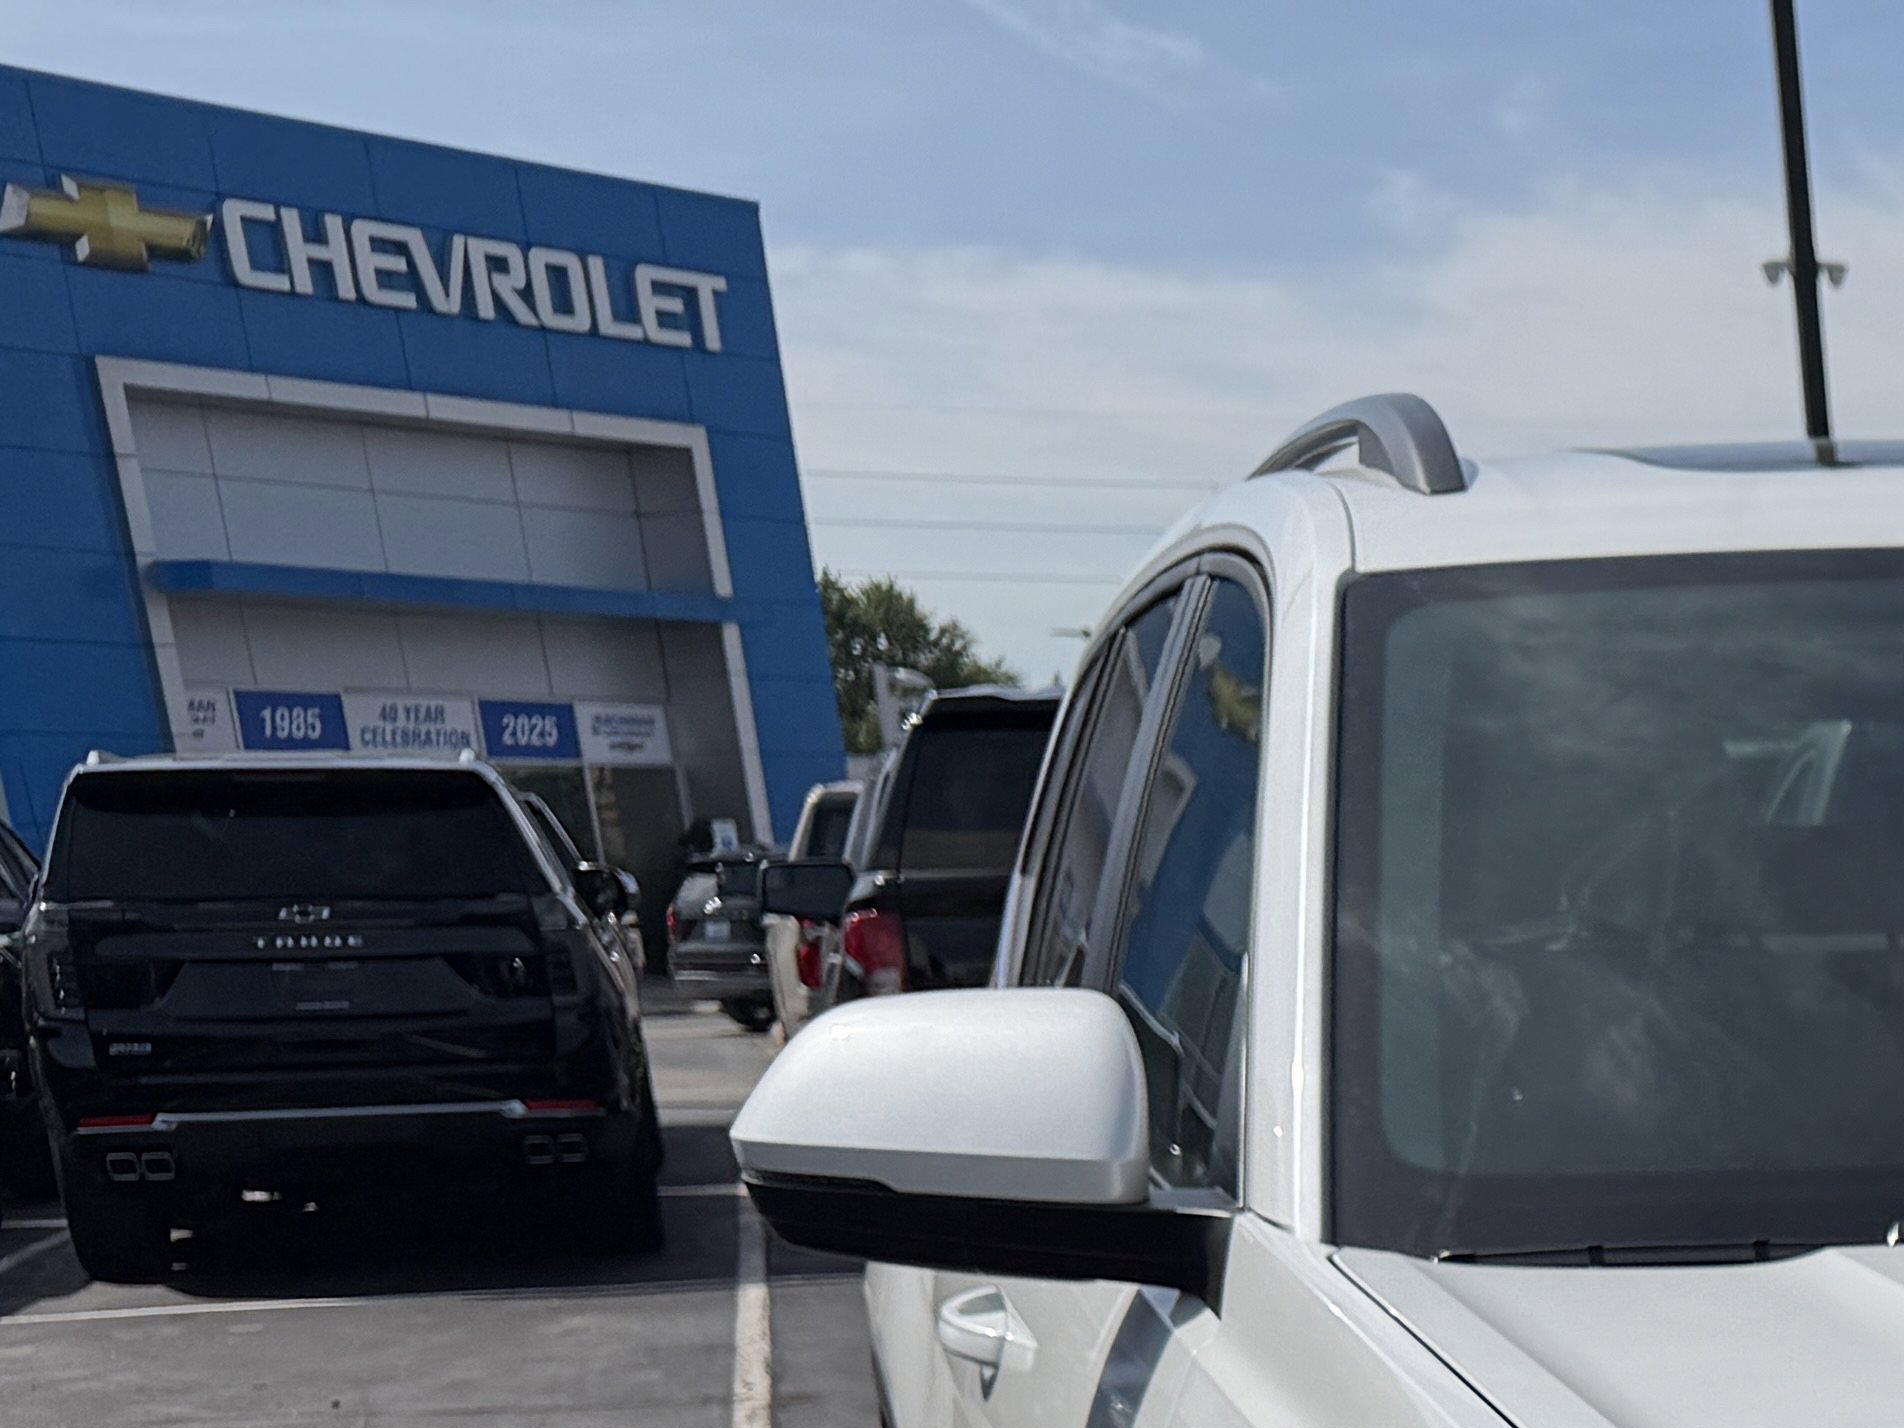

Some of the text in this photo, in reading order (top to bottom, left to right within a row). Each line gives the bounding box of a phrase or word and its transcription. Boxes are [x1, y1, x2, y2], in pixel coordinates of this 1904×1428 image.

[221, 198, 728, 353] CHEVROLET
[259, 704, 322, 741] 1985
[378, 702, 446, 726] 40 YEAR
[501, 713, 560, 748] 2025
[359, 725, 471, 750] CELEBRATION
